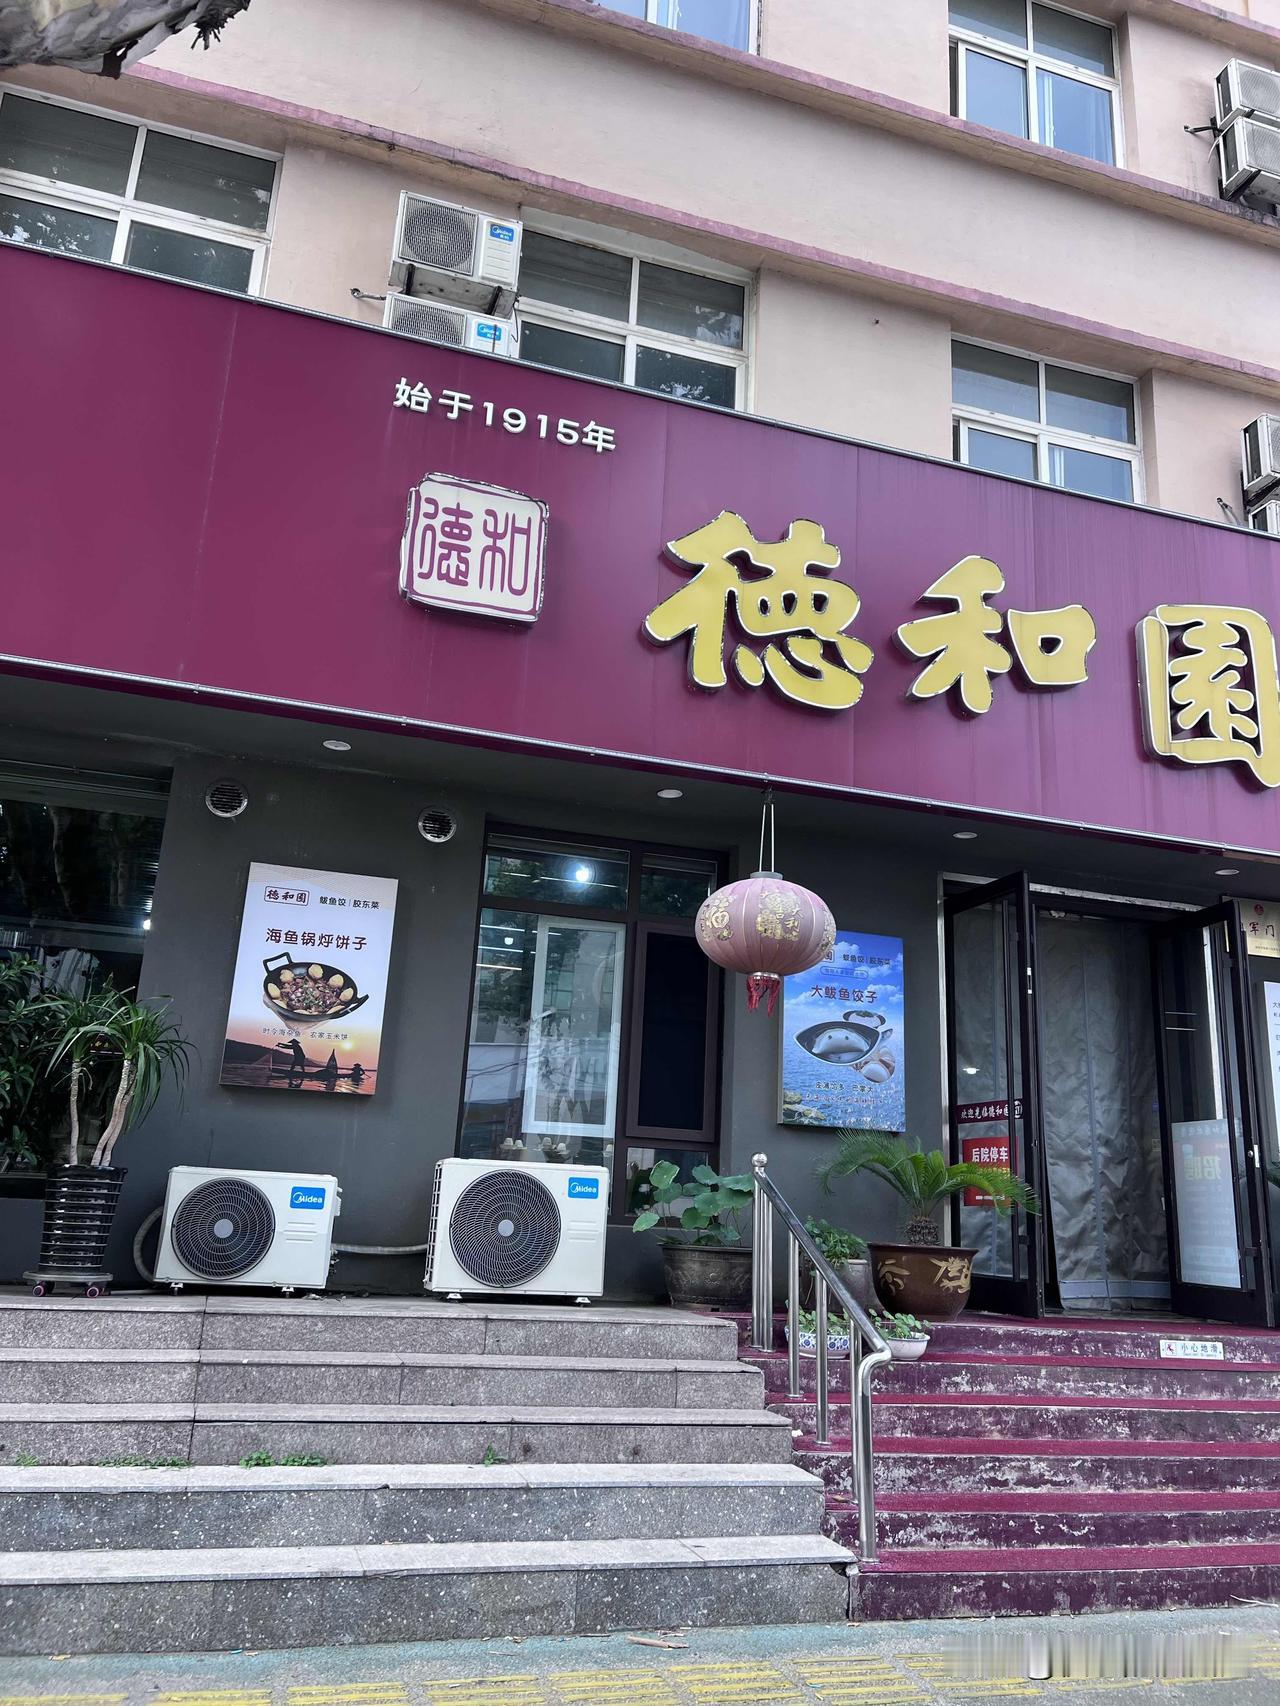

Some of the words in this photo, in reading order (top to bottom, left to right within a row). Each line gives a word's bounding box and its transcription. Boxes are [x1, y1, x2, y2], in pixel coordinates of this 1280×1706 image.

[393, 377, 616, 453] 始于1915年
[265, 927, 368, 951] 海鱼锅烀饼子
[810, 985, 877, 1004] 大鲅鱼饺子
[972, 1146, 1009, 1162] 后院停车
[570, 1182, 597, 1193] Midea
[293, 1191, 322, 1204] Midea
